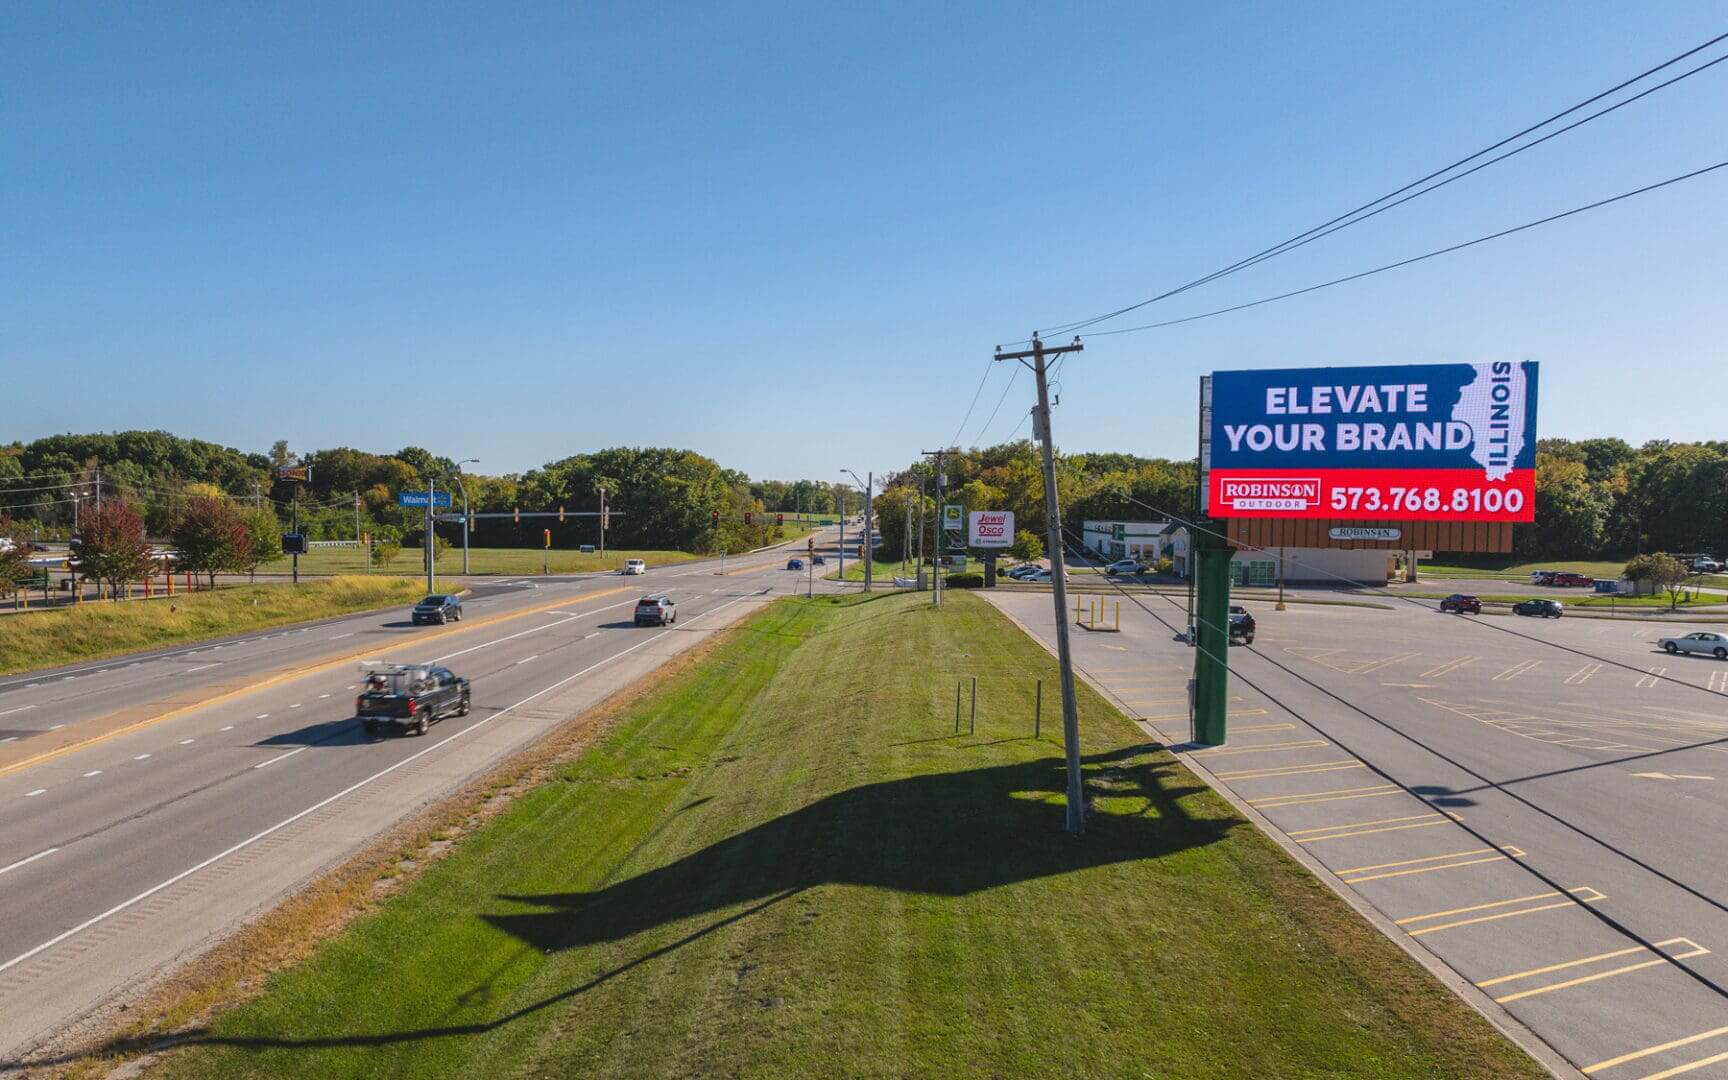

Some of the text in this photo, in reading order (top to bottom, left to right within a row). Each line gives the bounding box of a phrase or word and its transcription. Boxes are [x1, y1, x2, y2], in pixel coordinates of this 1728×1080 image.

[1266, 384, 1428, 414] ELEVATE
[1489, 361, 1511, 466] ILLINOIS
[1223, 421, 1473, 452] YOUR BRAND
[1226, 483, 1316, 497] ROBINSON
[403, 495, 437, 504] Walmat
[1239, 500, 1300, 508] OUTDOOR
[1331, 488, 1524, 513] 573.768.8100
[978, 514, 1006, 523] Jewel
[978, 525, 1004, 534] Osco
